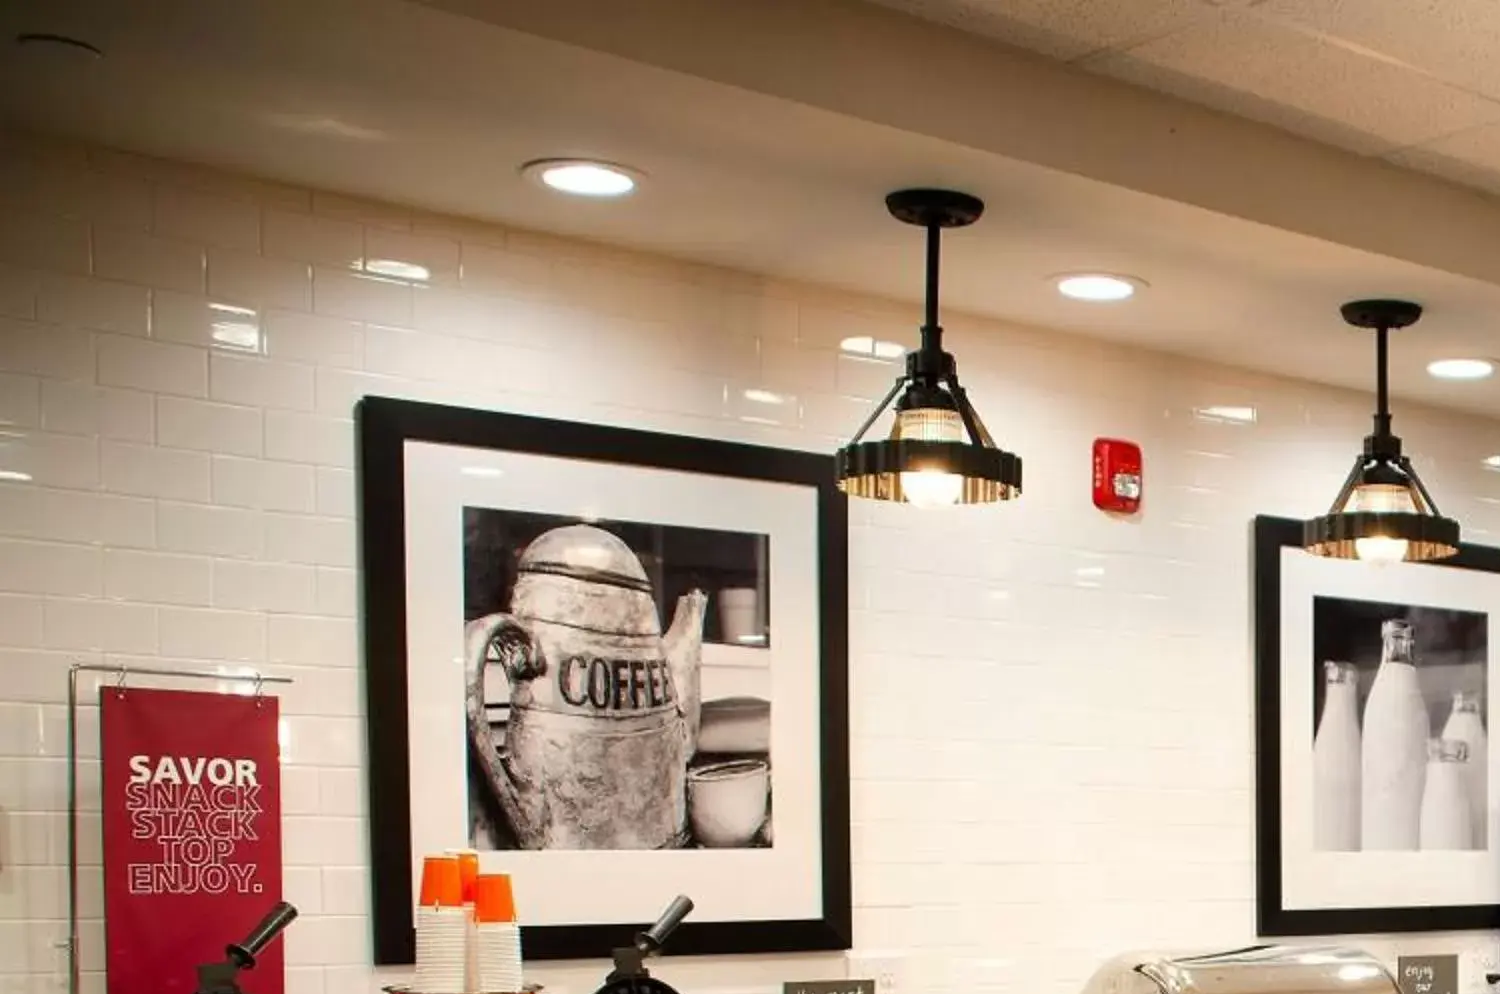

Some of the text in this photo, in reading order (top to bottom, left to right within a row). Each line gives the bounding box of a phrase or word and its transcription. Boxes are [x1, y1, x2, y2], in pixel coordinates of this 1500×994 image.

[559, 655, 672, 710] COFFEE
[129, 755, 257, 785] SAVOR
[126, 782, 262, 811] SNACK
[131, 810, 258, 839] STACK
[158, 836, 235, 866] TOP
[127, 863, 263, 894] ENJOY.
